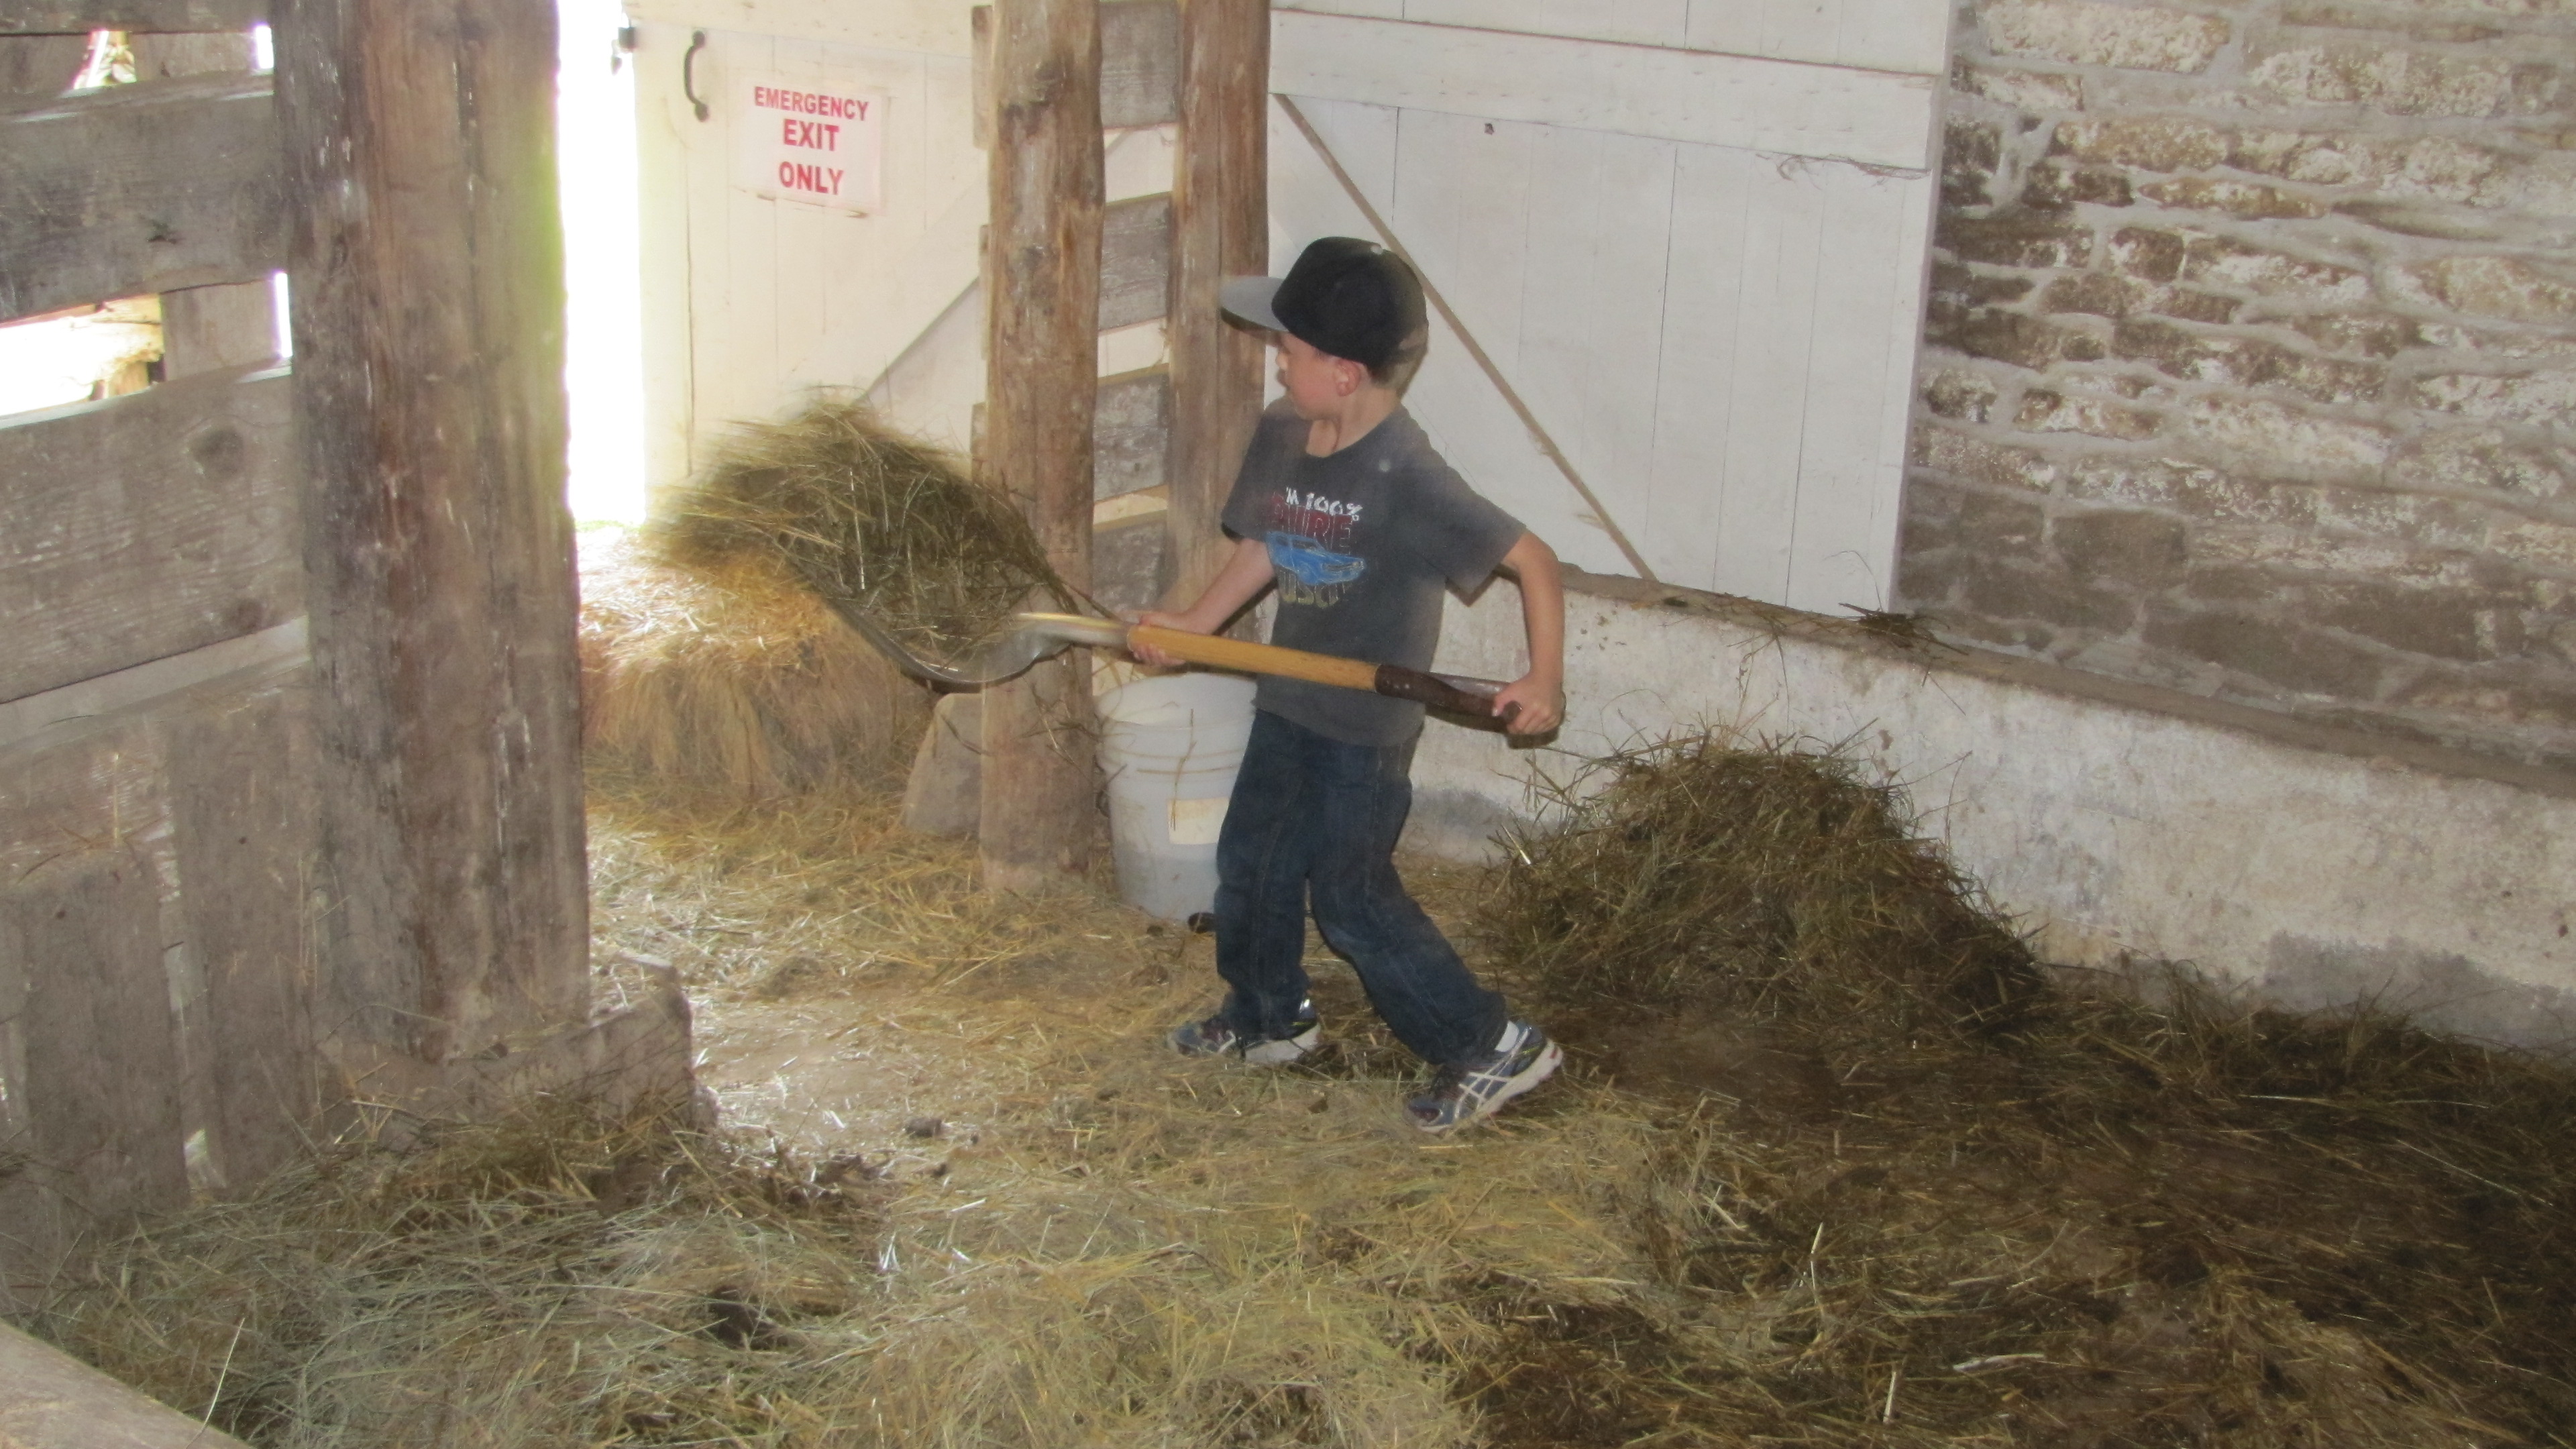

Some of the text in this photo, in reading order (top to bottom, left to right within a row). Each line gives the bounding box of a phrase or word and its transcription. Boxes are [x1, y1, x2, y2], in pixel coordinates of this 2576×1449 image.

[755, 86, 869, 121] EMERGENCY
[784, 119, 841, 152] EXIT
[779, 161, 844, 195] ONLY
